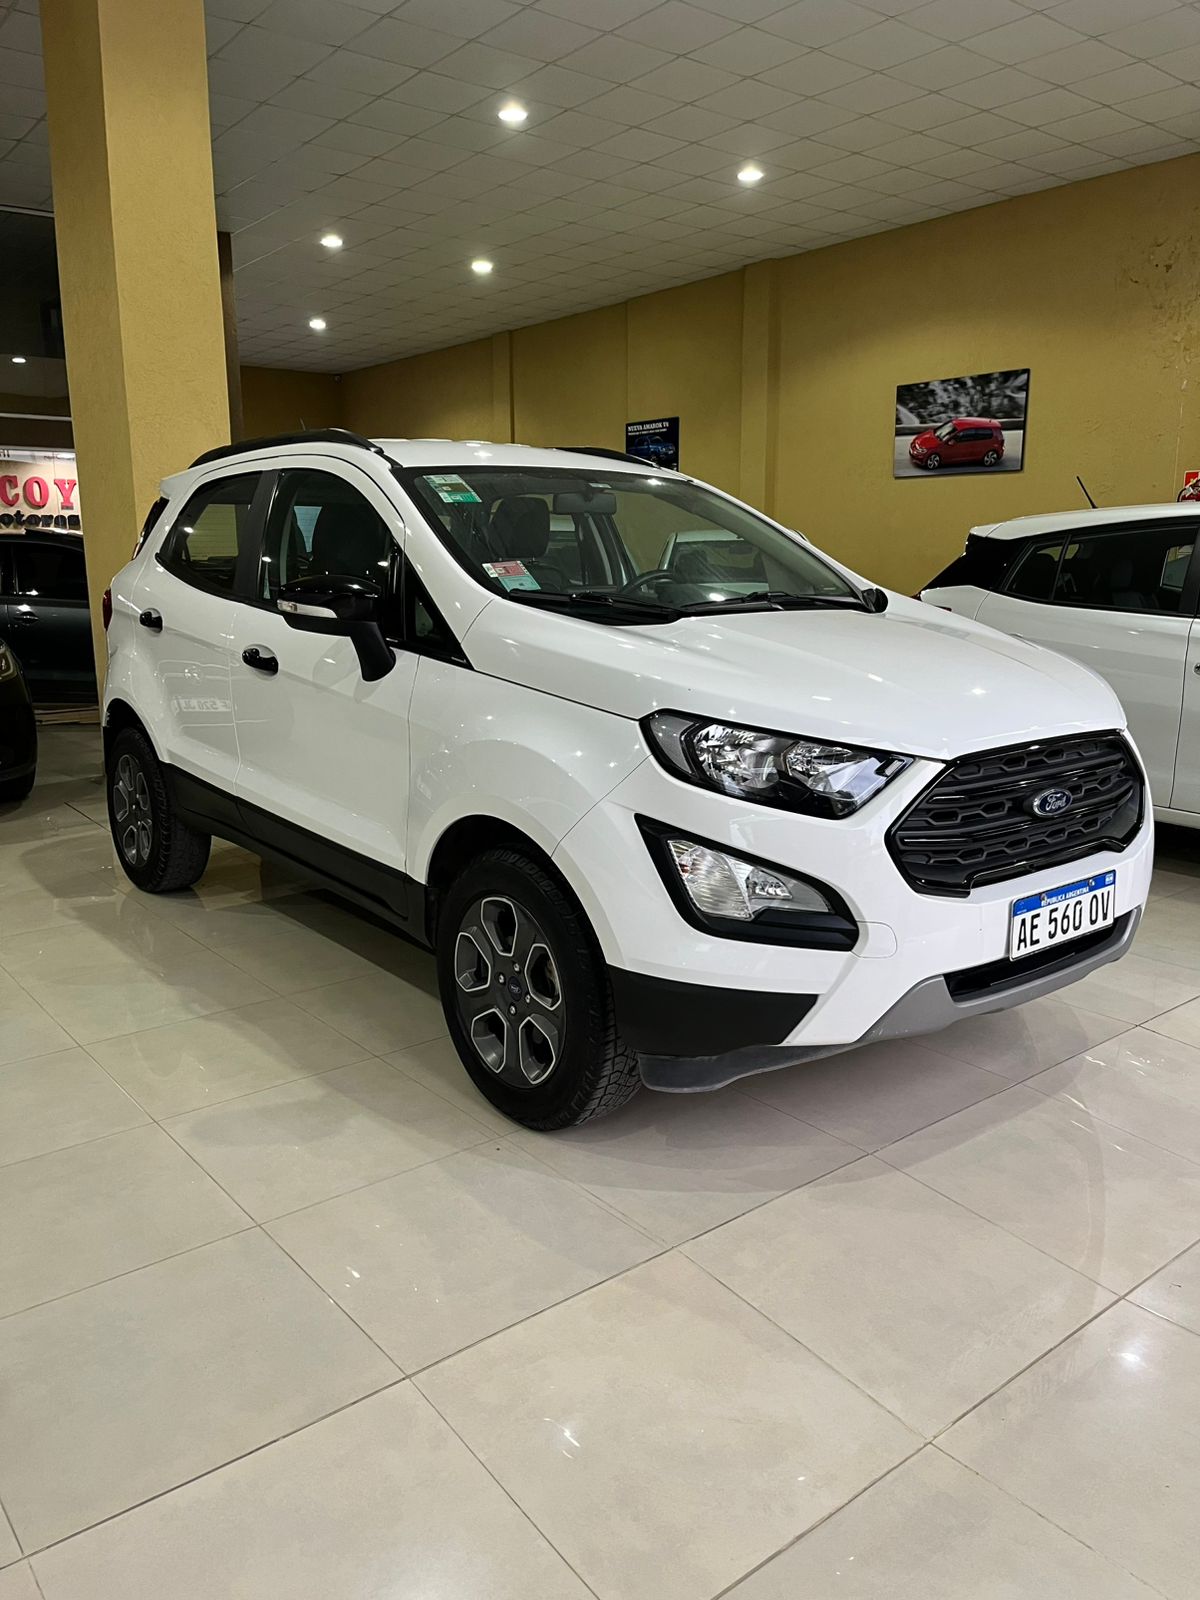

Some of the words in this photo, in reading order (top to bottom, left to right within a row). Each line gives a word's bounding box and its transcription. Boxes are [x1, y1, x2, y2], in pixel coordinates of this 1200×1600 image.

[1045, 793, 1067, 811] Ford
[1066, 886, 1089, 898] ARGENTINA
[1017, 913, 1040, 951] AE
[1048, 900, 1082, 939] 560
[1090, 890, 1110, 925] OV
